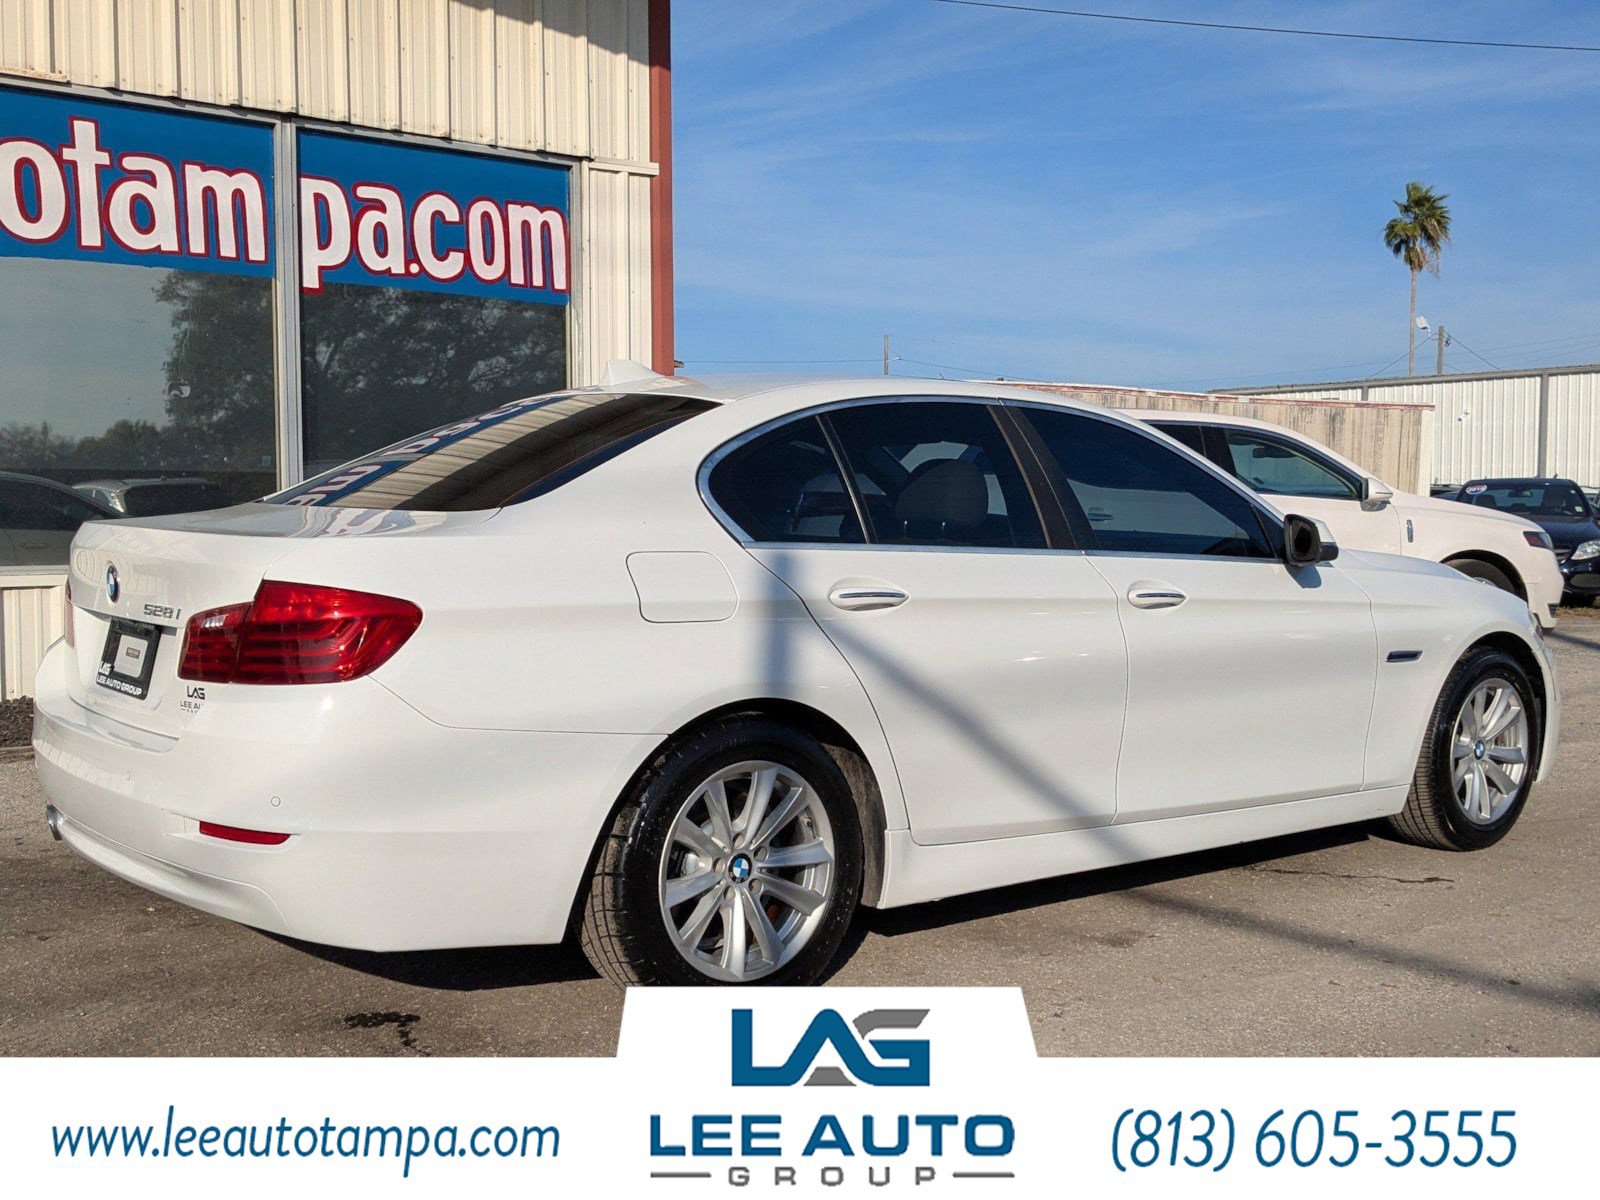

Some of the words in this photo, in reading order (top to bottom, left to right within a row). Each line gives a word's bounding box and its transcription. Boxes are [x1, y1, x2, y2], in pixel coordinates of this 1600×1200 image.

[97, 674, 107, 684] LEE
[106, 676, 121, 689] AUTO
[121, 683, 142, 696] GROUP
[186, 685, 205, 700] LAG
